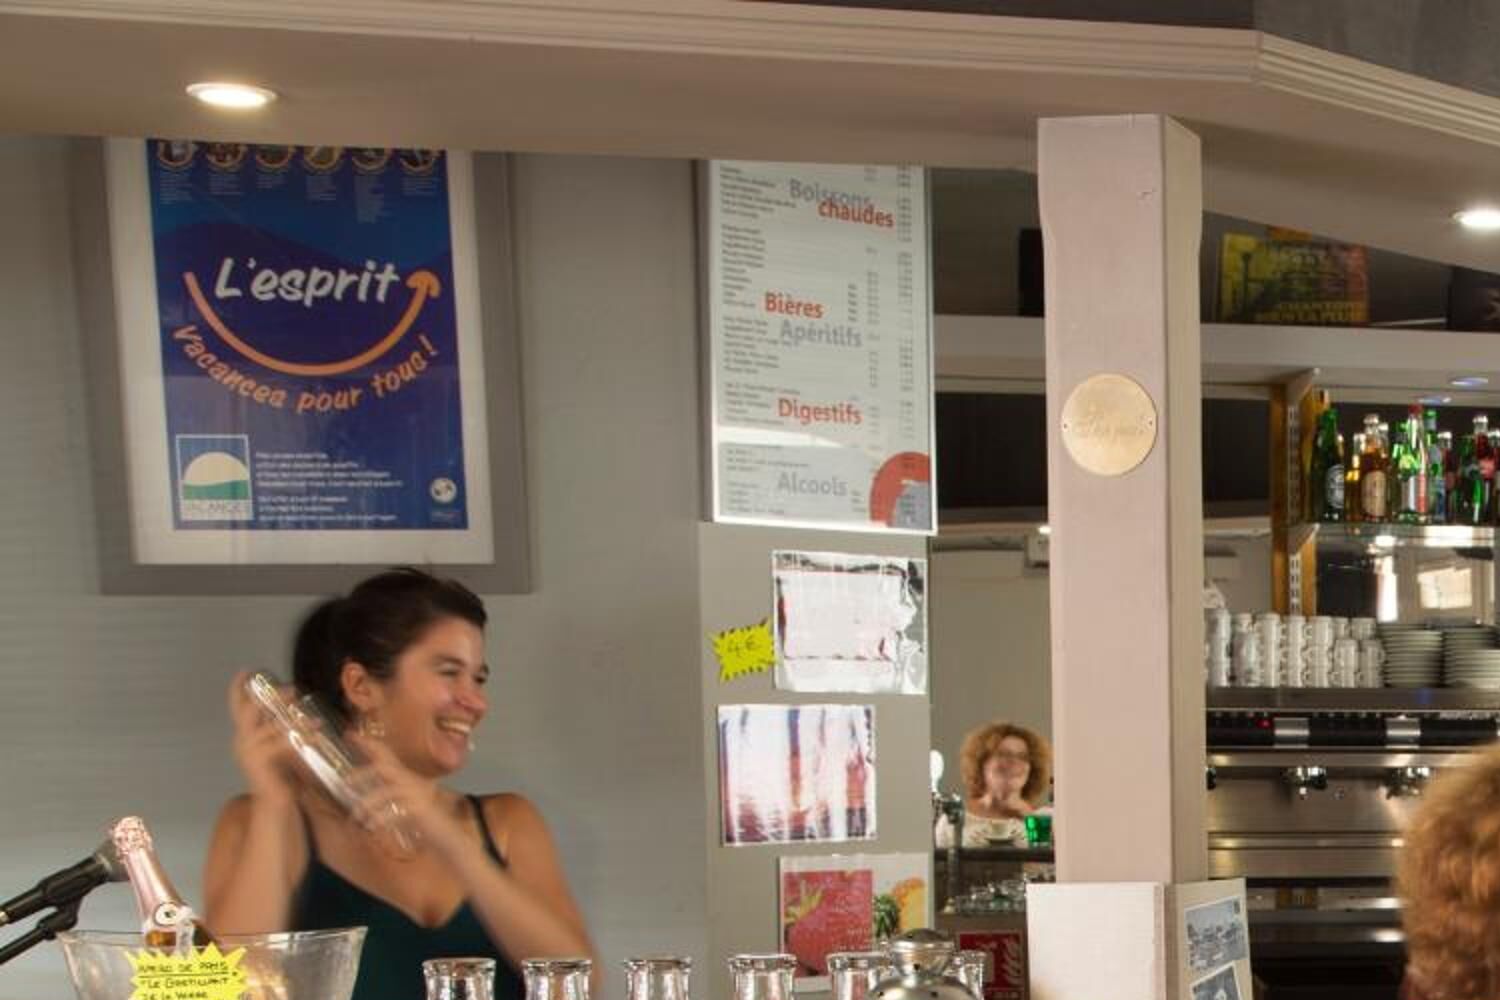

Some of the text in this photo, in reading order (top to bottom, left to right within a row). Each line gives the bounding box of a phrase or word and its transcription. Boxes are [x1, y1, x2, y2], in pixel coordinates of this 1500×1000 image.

[818, 197, 895, 228] chaudes
[214, 256, 400, 307] L'esprit
[763, 290, 824, 319] Bières
[780, 319, 863, 348] Apéritifs
[173, 324, 288, 409] Vacances
[296, 385, 363, 414] pour
[778, 397, 864, 426] Digestifs
[776, 471, 849, 497] Alcools
